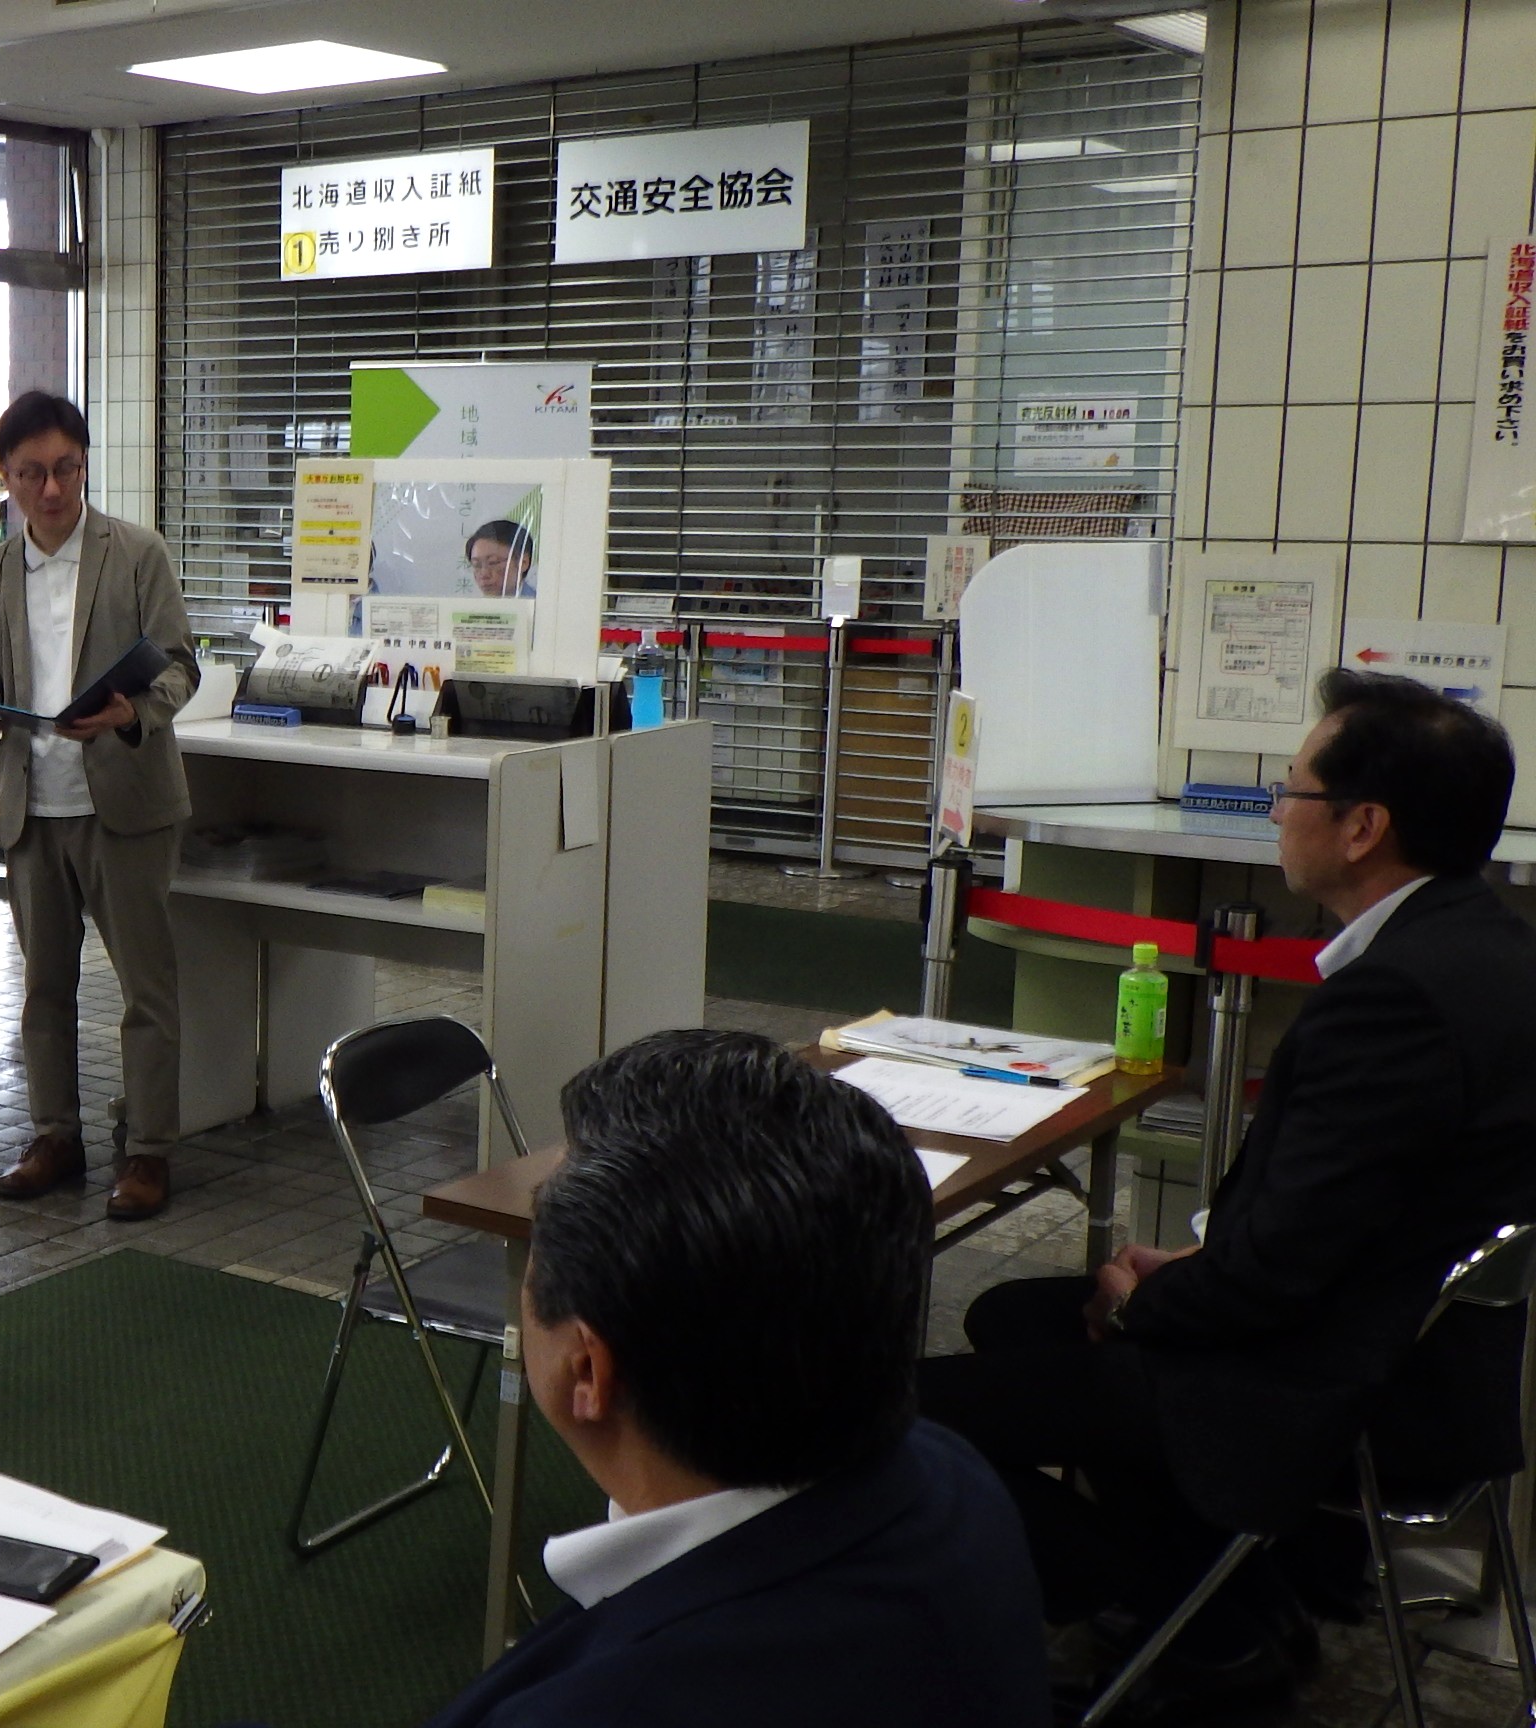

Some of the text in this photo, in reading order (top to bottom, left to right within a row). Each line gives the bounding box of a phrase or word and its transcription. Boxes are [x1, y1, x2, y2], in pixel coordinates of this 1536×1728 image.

[293, 170, 483, 211] 北海道収入証紙
[569, 168, 794, 220] 交通安全協会
[319, 222, 451, 255] 売り捌き所
[535, 405, 578, 414] KITAMI
